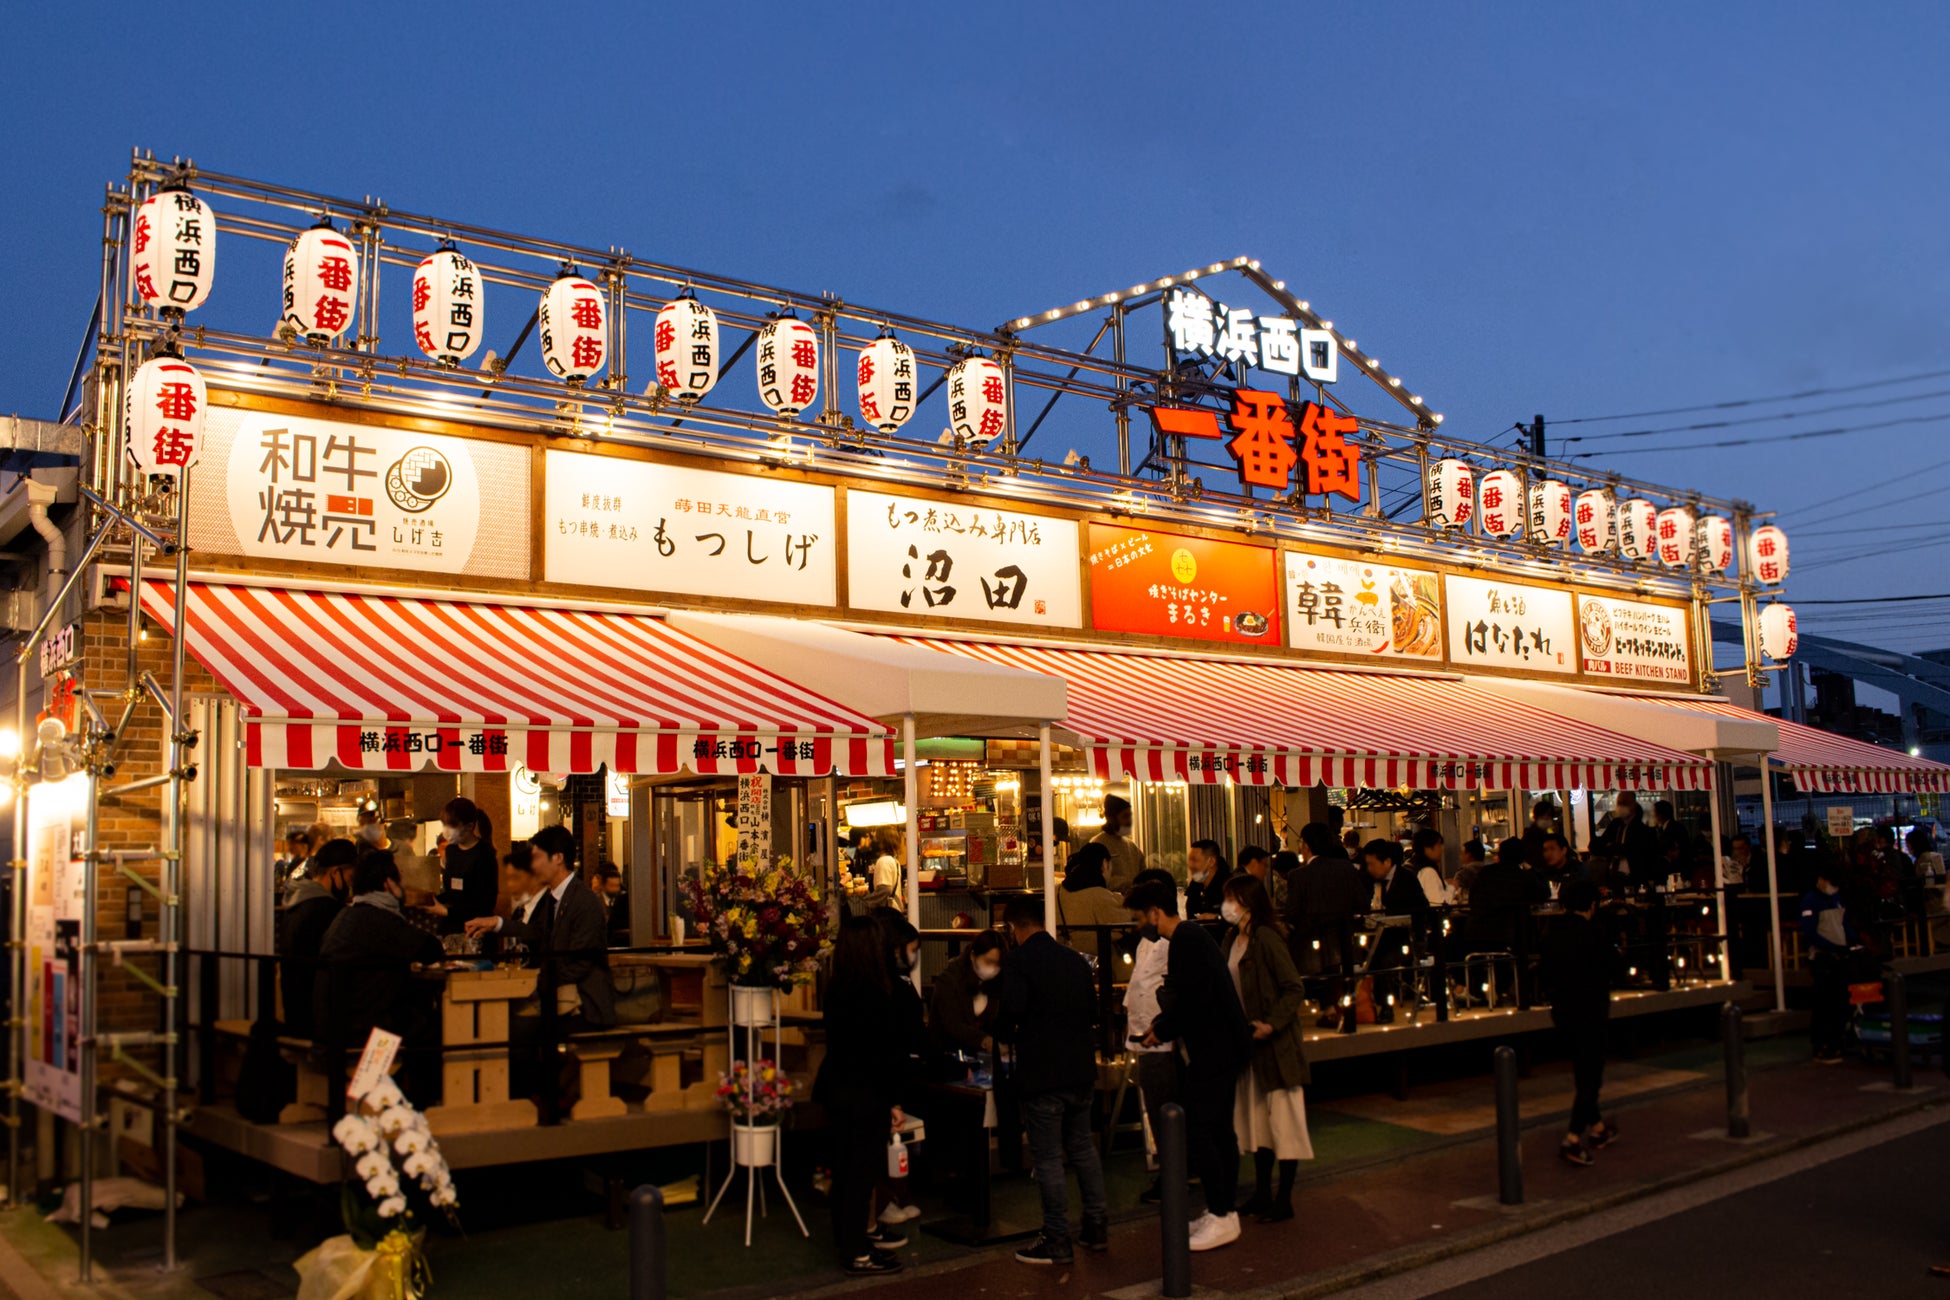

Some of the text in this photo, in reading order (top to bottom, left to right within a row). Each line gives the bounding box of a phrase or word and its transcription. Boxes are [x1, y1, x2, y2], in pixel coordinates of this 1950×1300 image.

[169, 194, 202, 304] 横浜西口
[313, 239, 353, 332] 一番街
[446, 254, 474, 351] 横浜西口
[571, 283, 602, 369] 一番街
[655, 305, 681, 389] 一番街
[688, 301, 711, 389] 横浜西口
[1168, 290, 1337, 383] 横浜西口
[759, 322, 784, 406] 横浜西口
[790, 325, 817, 405] 一番街
[858, 343, 881, 423] 一番街
[889, 341, 911, 422] 横浜西口
[152, 364, 197, 467] 一番街
[950, 360, 975, 440] 横浜西口
[978, 363, 1004, 437] 一番街
[258, 428, 378, 492] 和牛
[1153, 389, 1360, 502] 一番街
[888, 502, 1042, 545] もつ煮込み専門店
[1430, 463, 1449, 524] 横浜西口
[1453, 466, 1472, 523] 一番街
[1482, 476, 1504, 534] 一番街
[1576, 493, 1597, 549] 一番街
[393, 526, 443, 547] しげ吉
[653, 517, 819, 571] もつしげ
[1659, 511, 1679, 563] 一番街
[1757, 528, 1779, 580] 一番街
[900, 544, 1028, 610] 沼田
[1167, 602, 1210, 626] まるき
[1465, 619, 1552, 661] はなたれ
[1615, 661, 1687, 681] BEEF KITCHEN STAND
[359, 731, 509, 755] 横浜西口一番街
[693, 739, 815, 761] 横浜西口一番街
[1189, 755, 1268, 773] 横浜西口一番街
[739, 777, 750, 862] 横浜西口一番街
[750, 775, 762, 804] 祝開店
